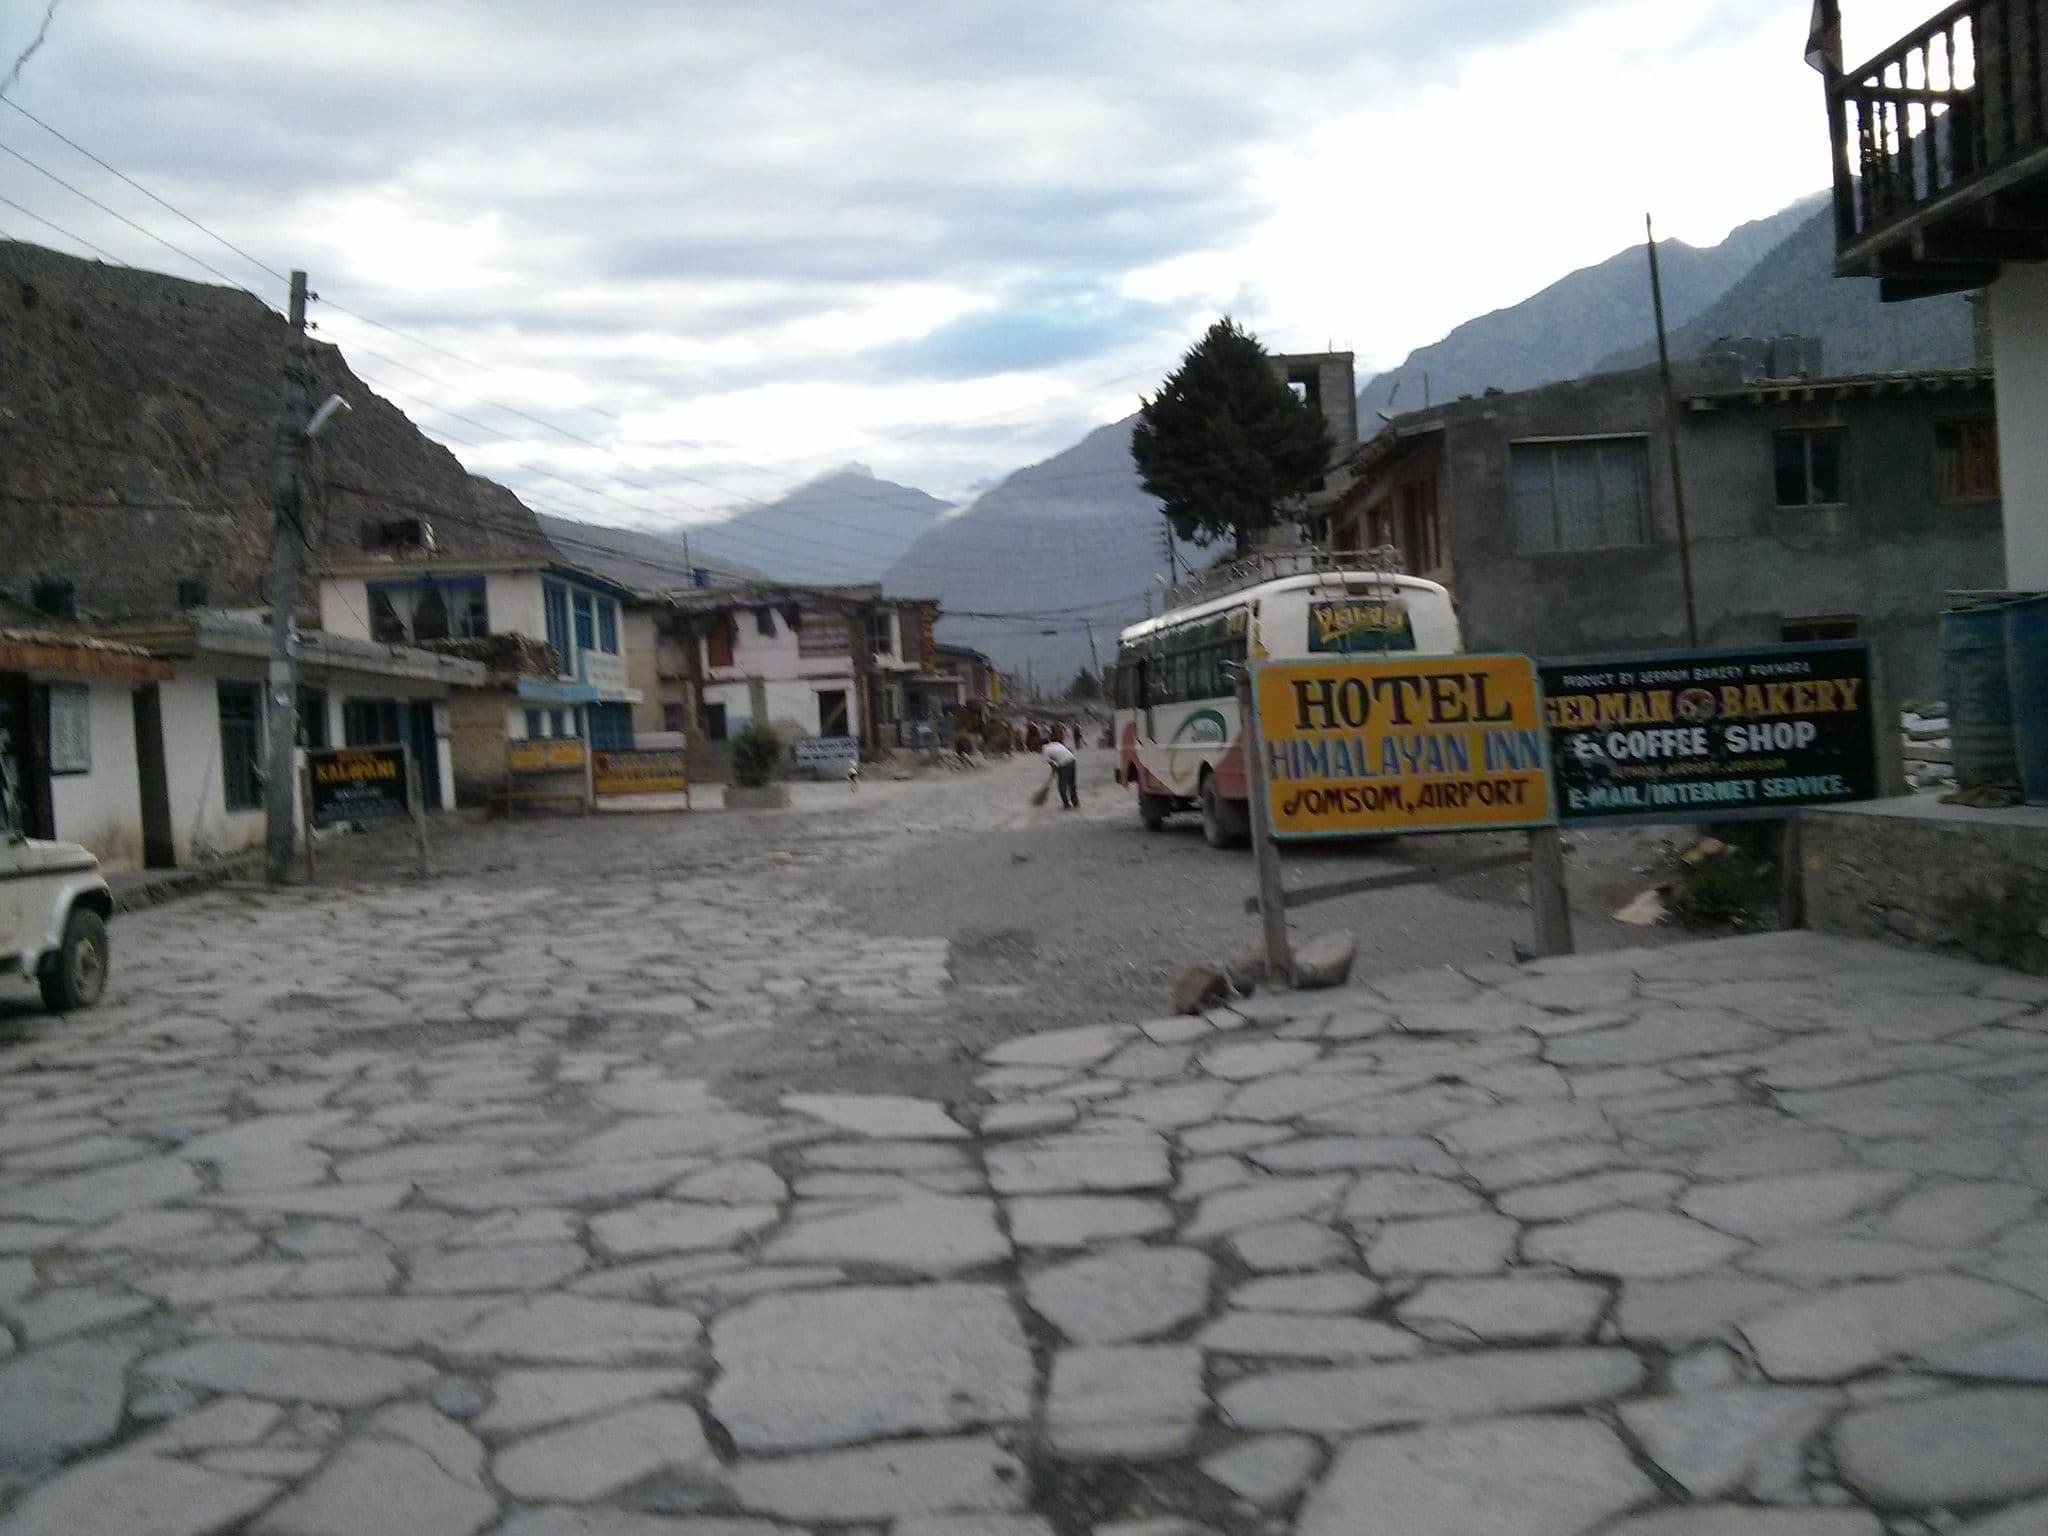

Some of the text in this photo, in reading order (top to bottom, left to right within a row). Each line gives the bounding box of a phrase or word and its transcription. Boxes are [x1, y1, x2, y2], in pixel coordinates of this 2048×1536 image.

[1291, 673, 1512, 730] HOTEL
[1720, 678, 1862, 719] BAKERY
[1266, 729, 1544, 780] HIMALAYAN INN
[1607, 727, 1709, 760] COFFEE
[1724, 721, 1818, 754] SHOP
